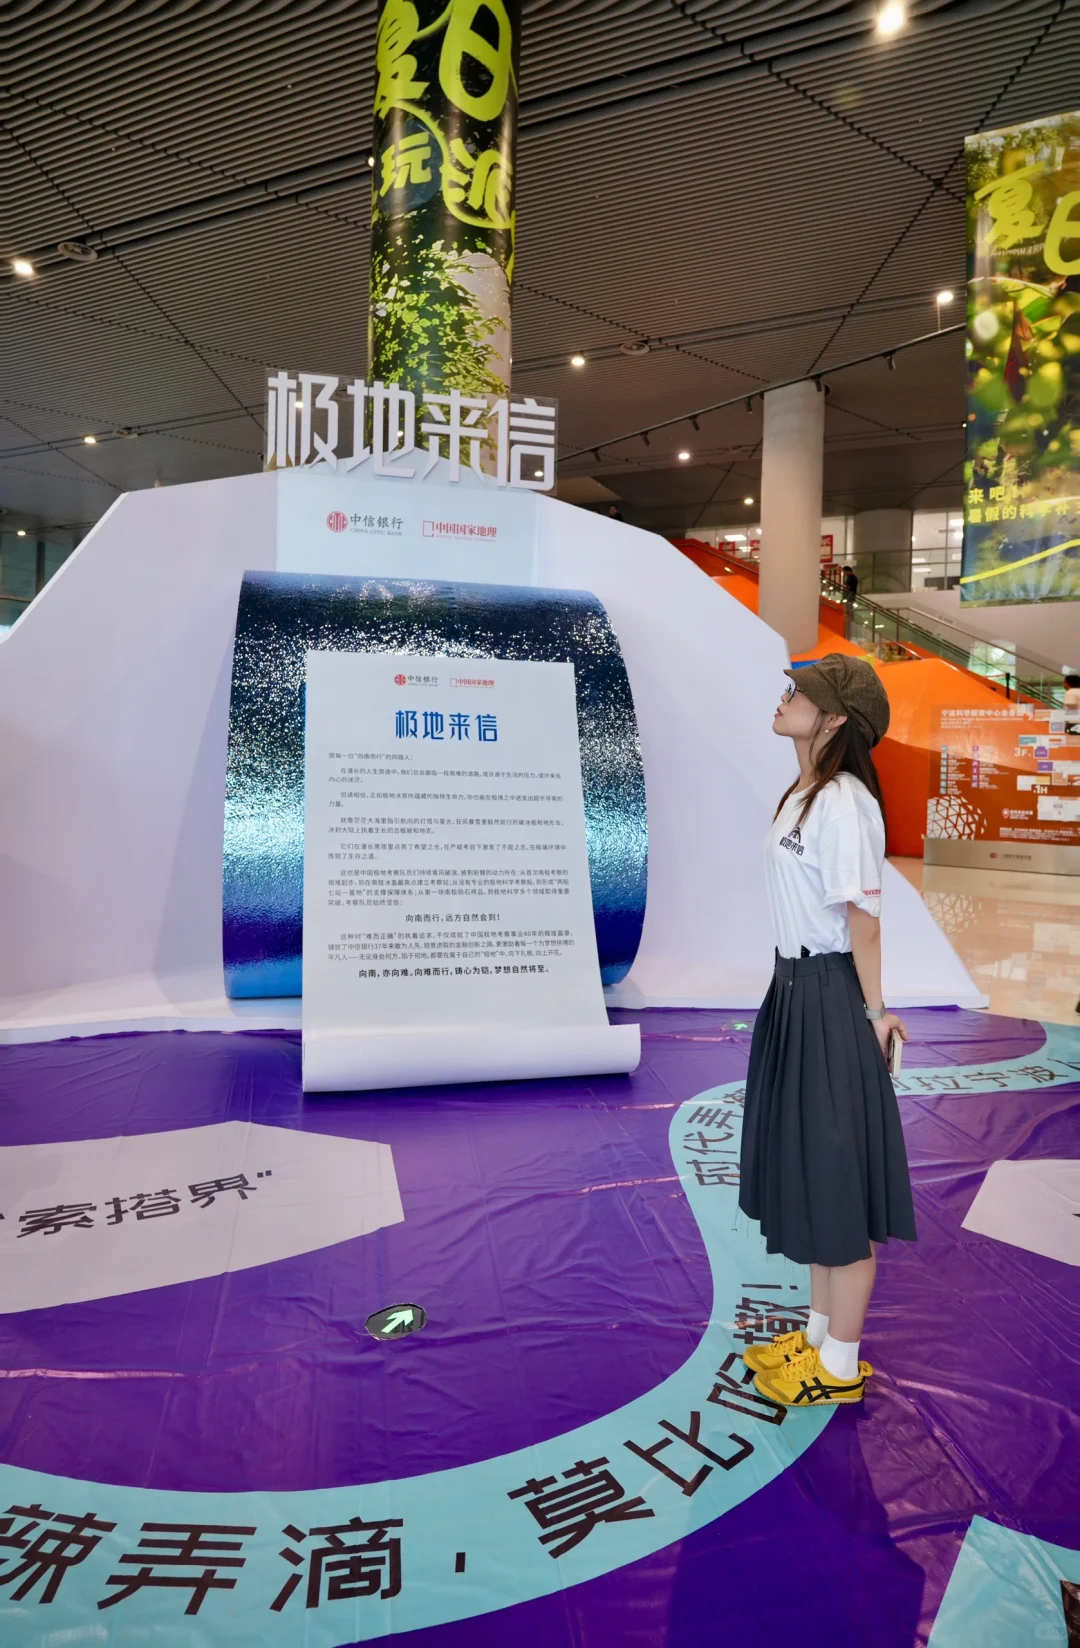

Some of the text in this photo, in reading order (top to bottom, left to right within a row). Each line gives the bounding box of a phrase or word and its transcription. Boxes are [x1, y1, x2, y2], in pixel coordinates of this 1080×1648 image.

[267, 372, 555, 491] 极地来信
[350, 513, 403, 530] 中信银行
[436, 521, 497, 538] 中国国家地理
[407, 675, 439, 684] 中信银行
[395, 710, 498, 742] 极地来信
